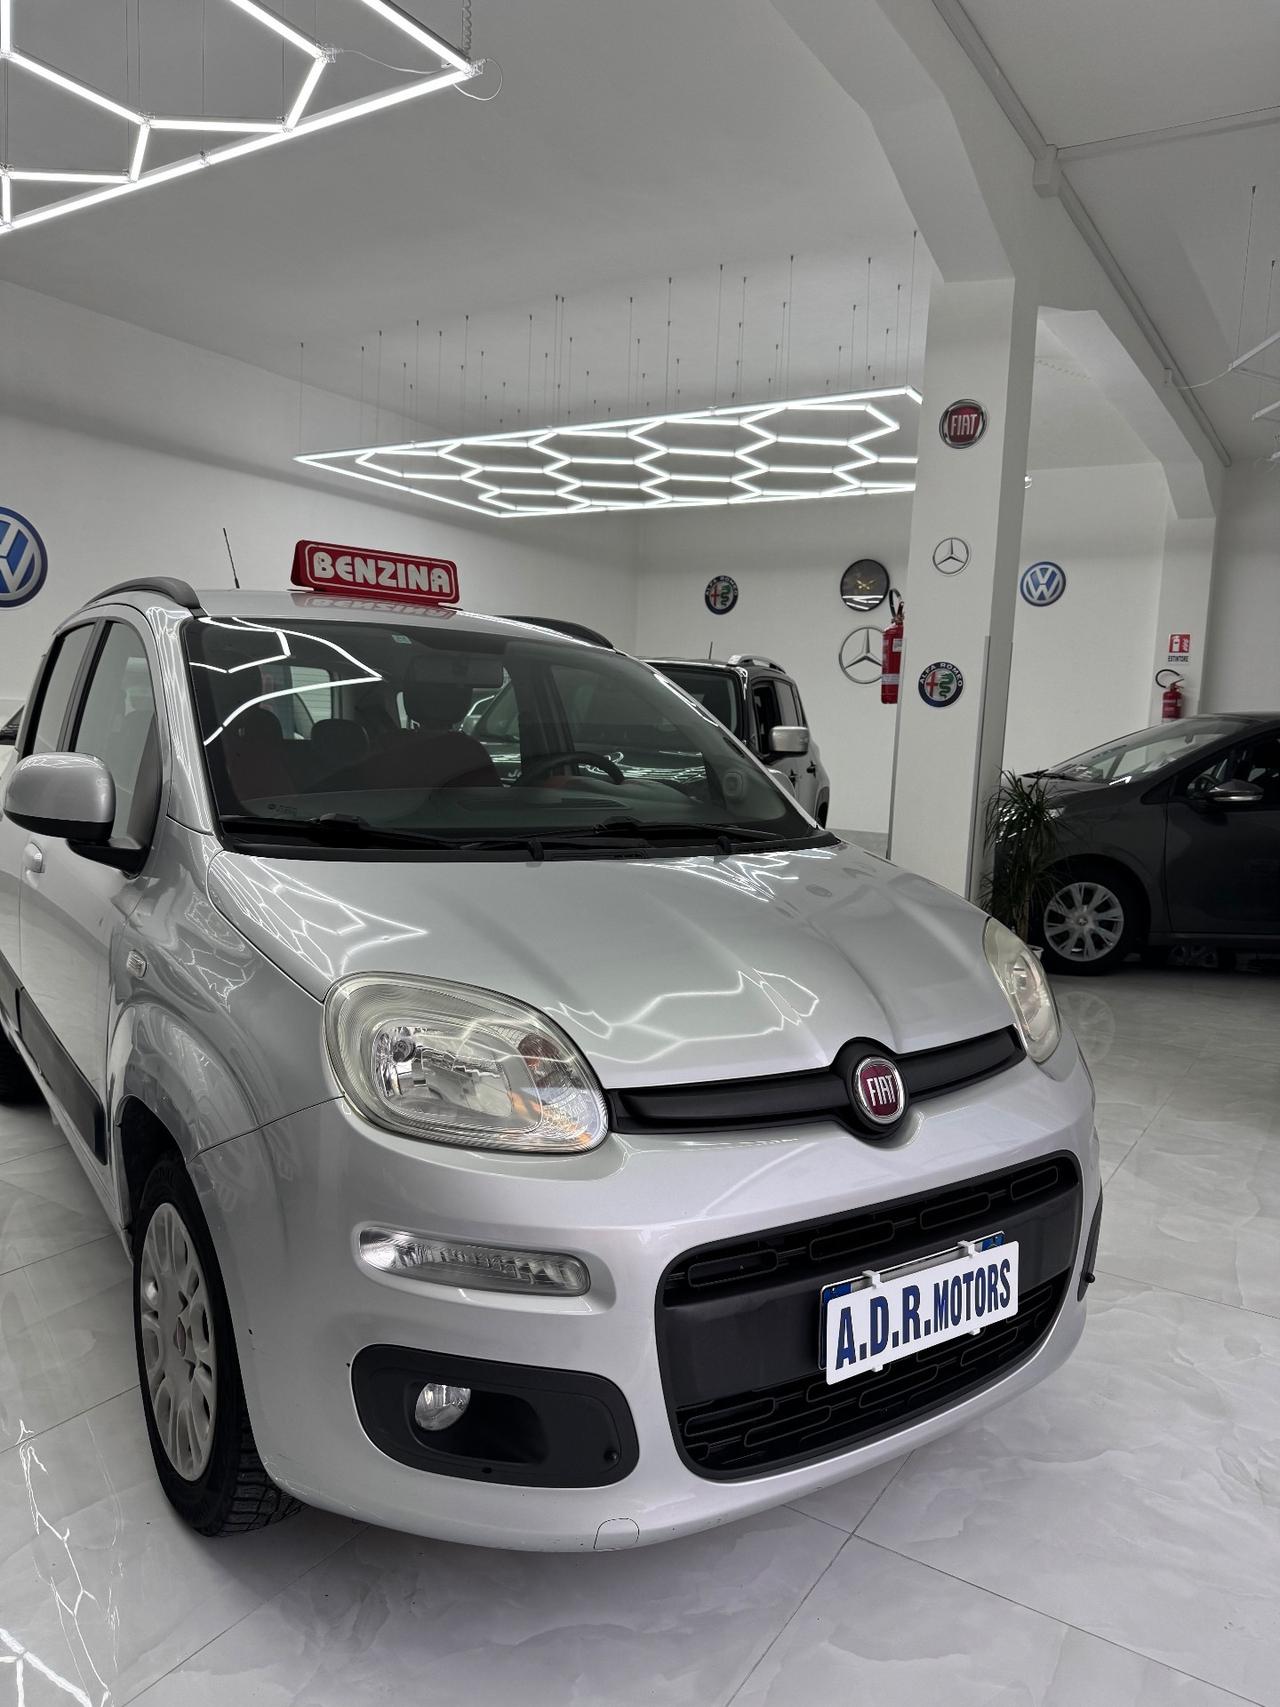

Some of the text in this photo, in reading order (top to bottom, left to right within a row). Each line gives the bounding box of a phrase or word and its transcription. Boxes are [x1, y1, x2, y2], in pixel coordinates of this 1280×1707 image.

[950, 414, 977, 435] FIAT
[312, 551, 451, 594] BENZINA
[919, 662, 963, 687] ALFA ROMEO
[866, 1074, 896, 1107] FIAT
